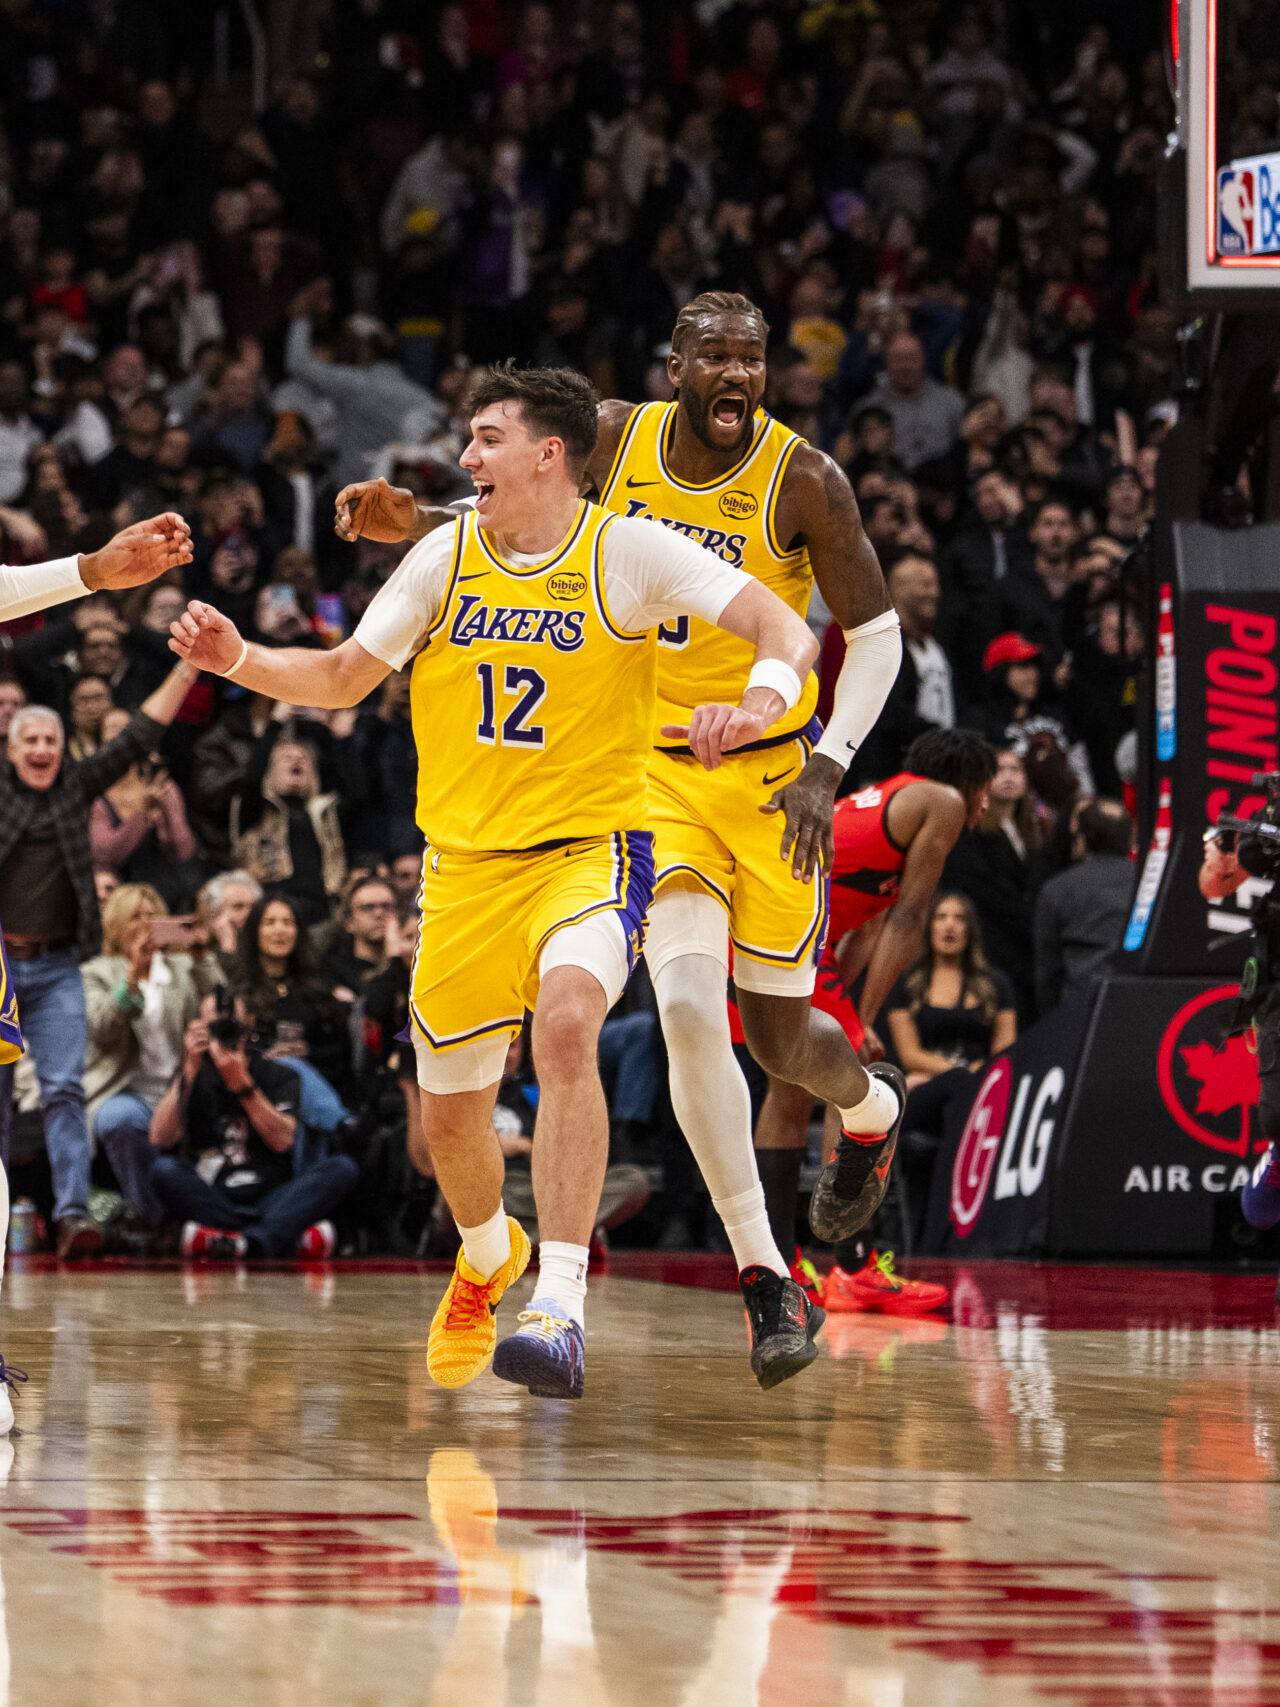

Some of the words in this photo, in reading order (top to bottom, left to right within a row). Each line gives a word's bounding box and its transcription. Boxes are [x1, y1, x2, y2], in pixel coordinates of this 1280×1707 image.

[723, 496, 756, 513] bibigo
[551, 580, 586, 592] bibigo
[449, 594, 587, 653] LAKERS
[476, 661, 548, 750] 12
[994, 1065, 1065, 1200] LG
[1124, 1165, 1192, 1192] AIR
